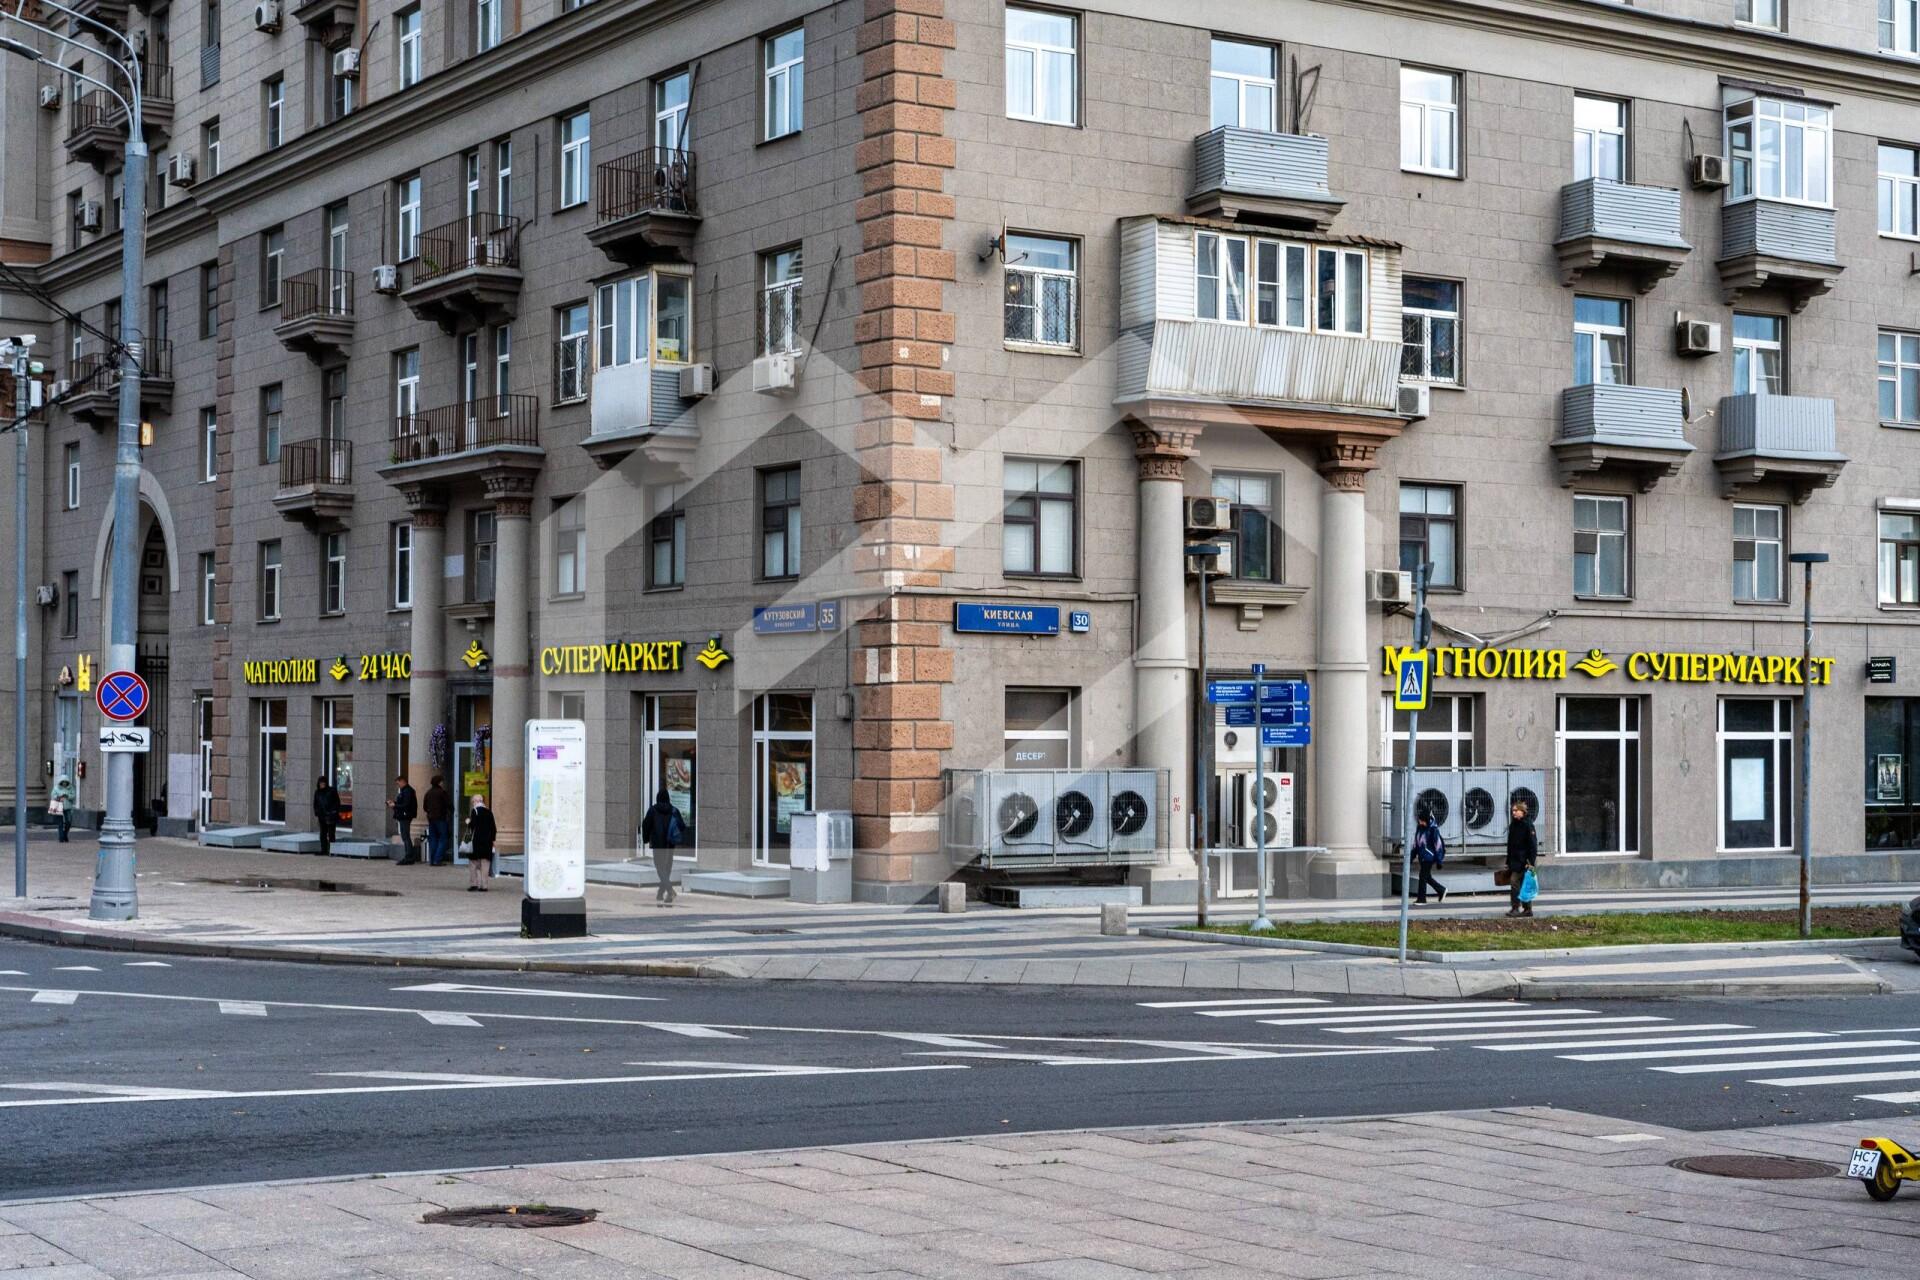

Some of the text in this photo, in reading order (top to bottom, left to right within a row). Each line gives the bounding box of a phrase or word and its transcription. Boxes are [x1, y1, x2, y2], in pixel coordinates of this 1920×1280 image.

[763, 607, 806, 621] КУТУЗОВСКИЙ
[821, 608, 834, 624] 35
[983, 609, 1033, 620] КИЕВСКАЯ
[1075, 614, 1088, 626] 30
[540, 640, 682, 675] СУПЕРМАРКЕТ
[1384, 645, 1568, 678] МГНОЛИЯ
[244, 659, 316, 684] МАГНОЛИЯ
[359, 654, 378, 680] 24
